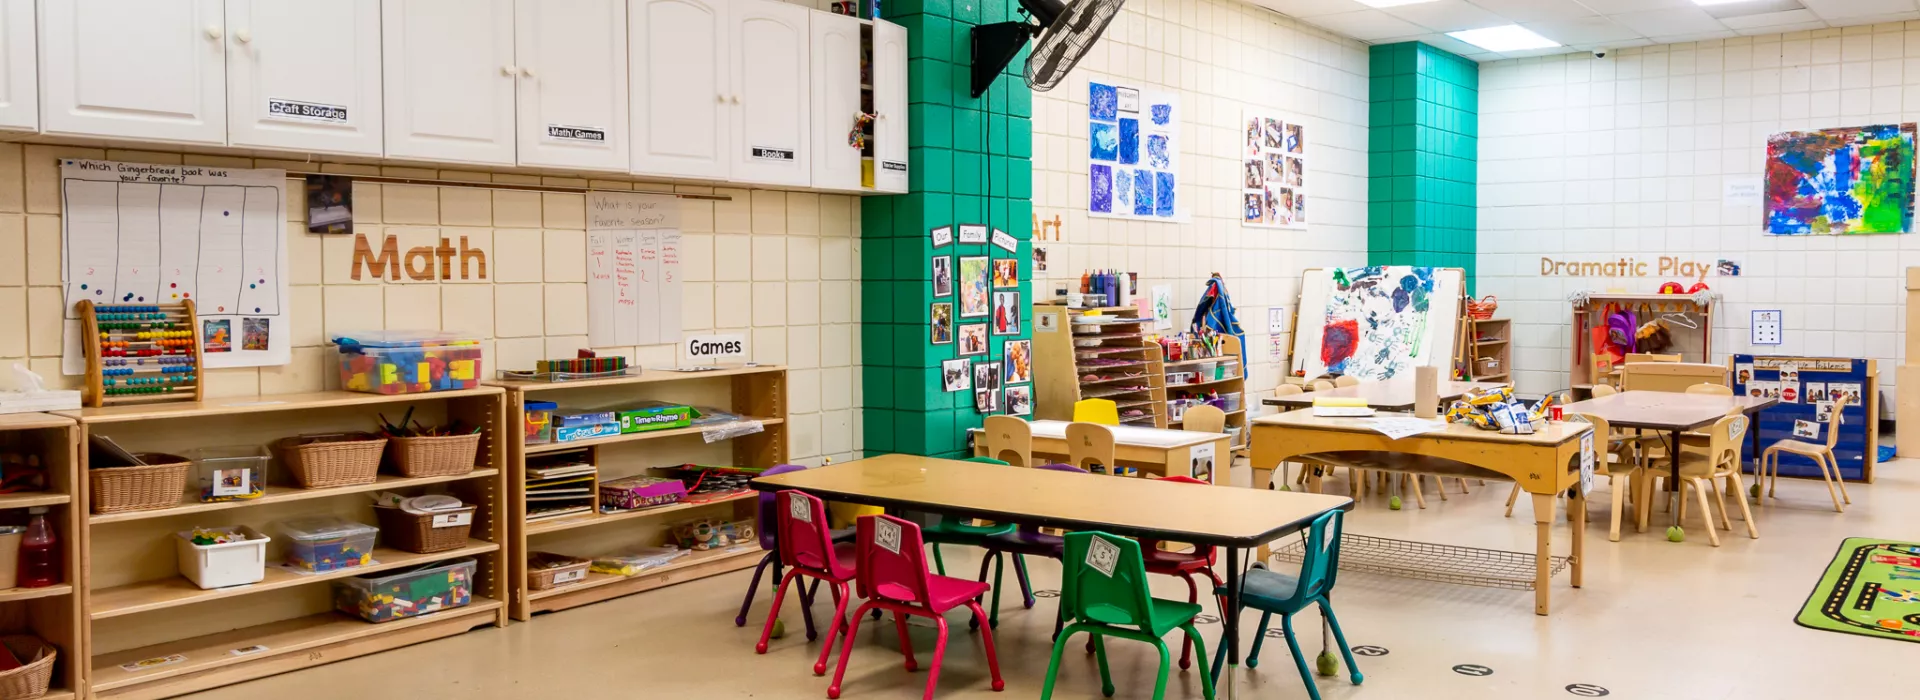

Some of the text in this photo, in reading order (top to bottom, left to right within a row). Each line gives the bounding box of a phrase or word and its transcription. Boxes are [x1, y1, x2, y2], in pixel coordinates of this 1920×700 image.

[271, 102, 345, 119] Craft Storage
[551, 127, 602, 140] Math/ Games
[761, 149, 785, 159] Books
[79, 161, 228, 178] Which Gingerbread book was
[119, 174, 186, 184] your favorite?
[594, 196, 657, 214] What is your
[1032, 212, 1062, 241] Art
[590, 235, 605, 244] Fall
[936, 232, 948, 242] Our
[963, 229, 982, 241] Family
[350, 233, 487, 281] Math
[1541, 256, 1711, 282] Dramatic Play
[690, 339, 742, 356] Games
[1815, 360, 1846, 370] Problems
[635, 415, 652, 424] Time
[655, 413, 679, 423] Rhyme
